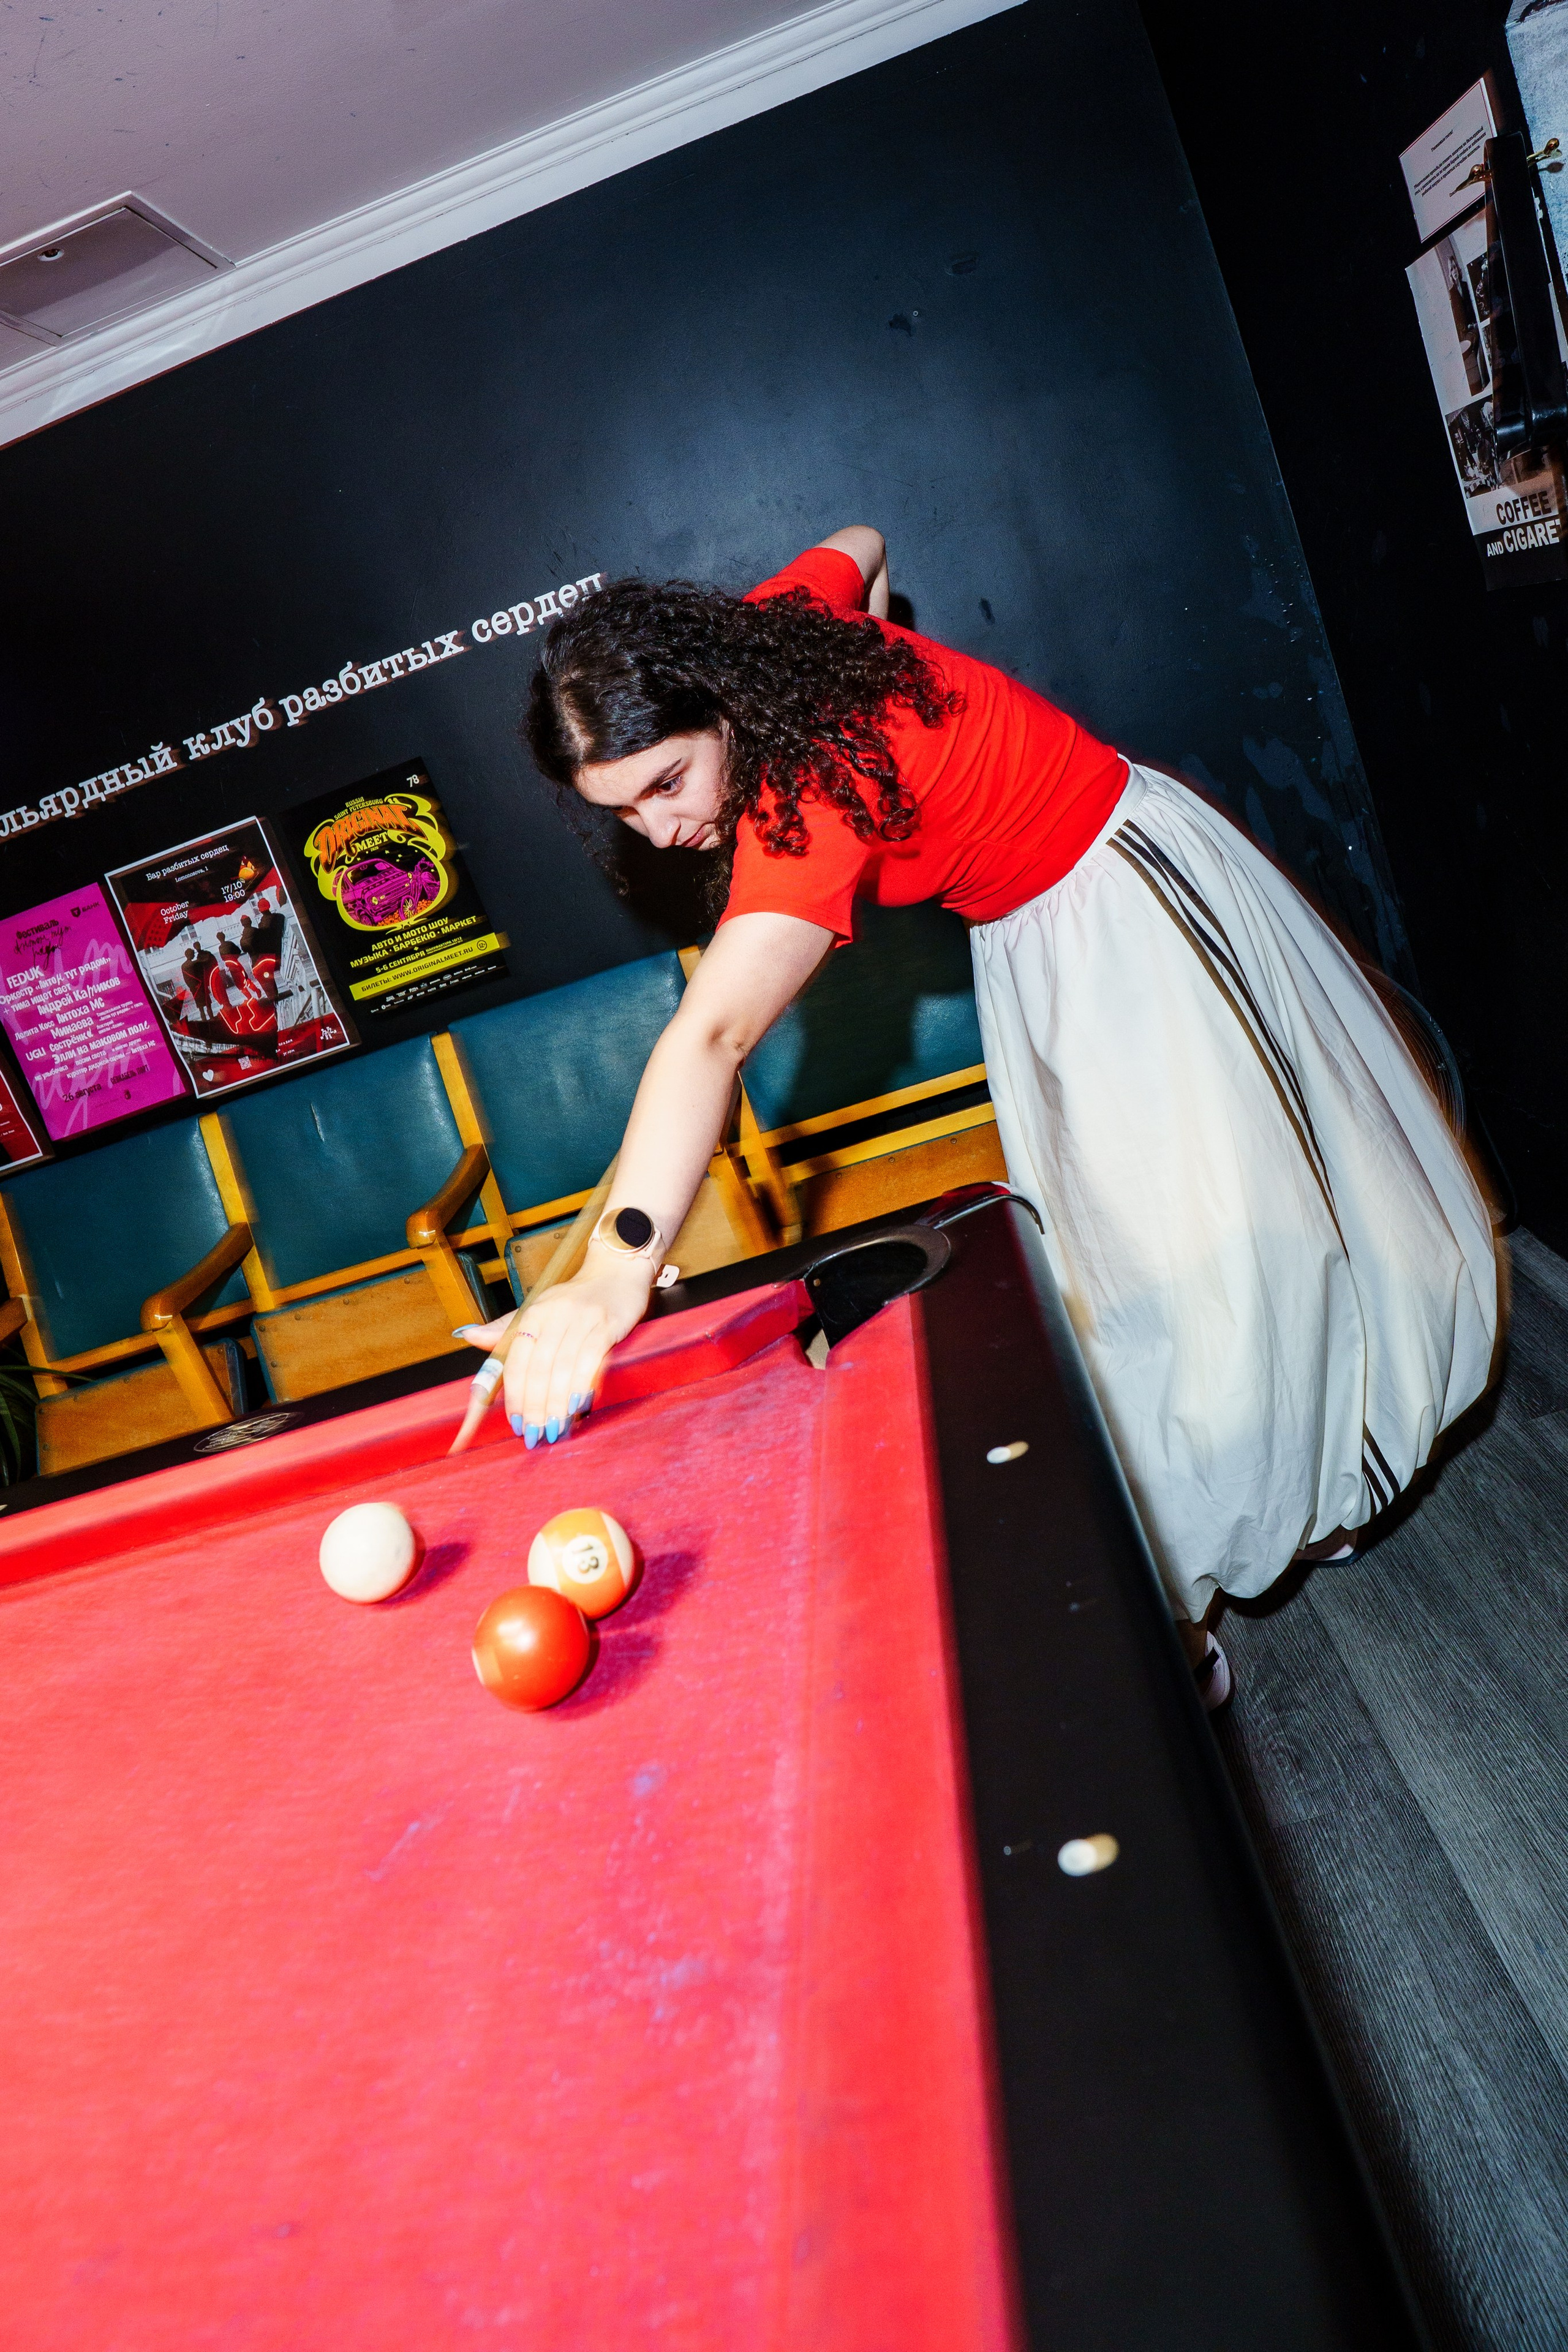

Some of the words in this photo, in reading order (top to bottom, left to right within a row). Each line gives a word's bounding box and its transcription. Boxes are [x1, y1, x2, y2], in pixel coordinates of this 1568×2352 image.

[1496, 491, 1551, 525] COFFEE
[1487, 541, 1504, 557] AND
[0, 742, 177, 837] льярдный
[183, 697, 274, 760] клуб
[278, 630, 464, 727] разбитых
[406, 774, 420, 788] 78
[334, 809, 349, 821] SAINT
[349, 798, 383, 814] PETERSBURG
[345, 796, 364, 808] RUSSIA
[313, 804, 428, 873] ORIGINAL
[356, 831, 388, 853] MEET
[146, 872, 161, 881] Бар
[162, 855, 200, 876] разбитых
[200, 845, 229, 860] сердец
[175, 869, 205, 883] Lomonosova,
[221, 880, 243, 895] 17/10
[82, 902, 100, 912] БАНК
[223, 889, 246, 903] 19:00
[160, 900, 189, 916] October
[163, 910, 189, 925] Friday
[16, 919, 59, 940] Фестиваль
[371, 937, 394, 951] АВТО
[395, 933, 402, 942] И
[402, 924, 428, 939] МОТО
[428, 917, 448, 930] ШОУ
[350, 950, 389, 968] МУЗЫКА
[393, 931, 436, 952] БАРБЕКЮ
[441, 916, 477, 934] МАРКЕТ
[361, 977, 392, 992] БИЛЕТЫ:
[392, 946, 473, 980] WWW.ORIGINALMEET.RU
[375, 965, 388, 973] 5-6
[388, 950, 426, 968] СЕНТЯБРЯ
[0, 986, 34, 1005] Оркестр
[64, 969, 78, 980] тут
[78, 957, 111, 976] рядом»
[6, 965, 45, 989] FEDUK
[10, 999, 30, 1012] тима
[30, 992, 53, 1005] ищет
[53, 983, 72, 995] свет
[37, 994, 74, 1016] Андрей
[15, 1027, 39, 1041] Лолита
[39, 1020, 55, 1033] Косс
[56, 1005, 91, 1024] Антоха
[50, 1016, 94, 1039] Минаева
[49, 1028, 94, 1052] Сестрёнка
[51, 1049, 77, 1065] Элли
[77, 1043, 89, 1054] на
[89, 1031, 128, 1051] маковом
[128, 1020, 150, 1036] поле
[62, 1093, 74, 1103] 26
[75, 1084, 102, 1099] августа
[573, 1544, 600, 1575] 13
